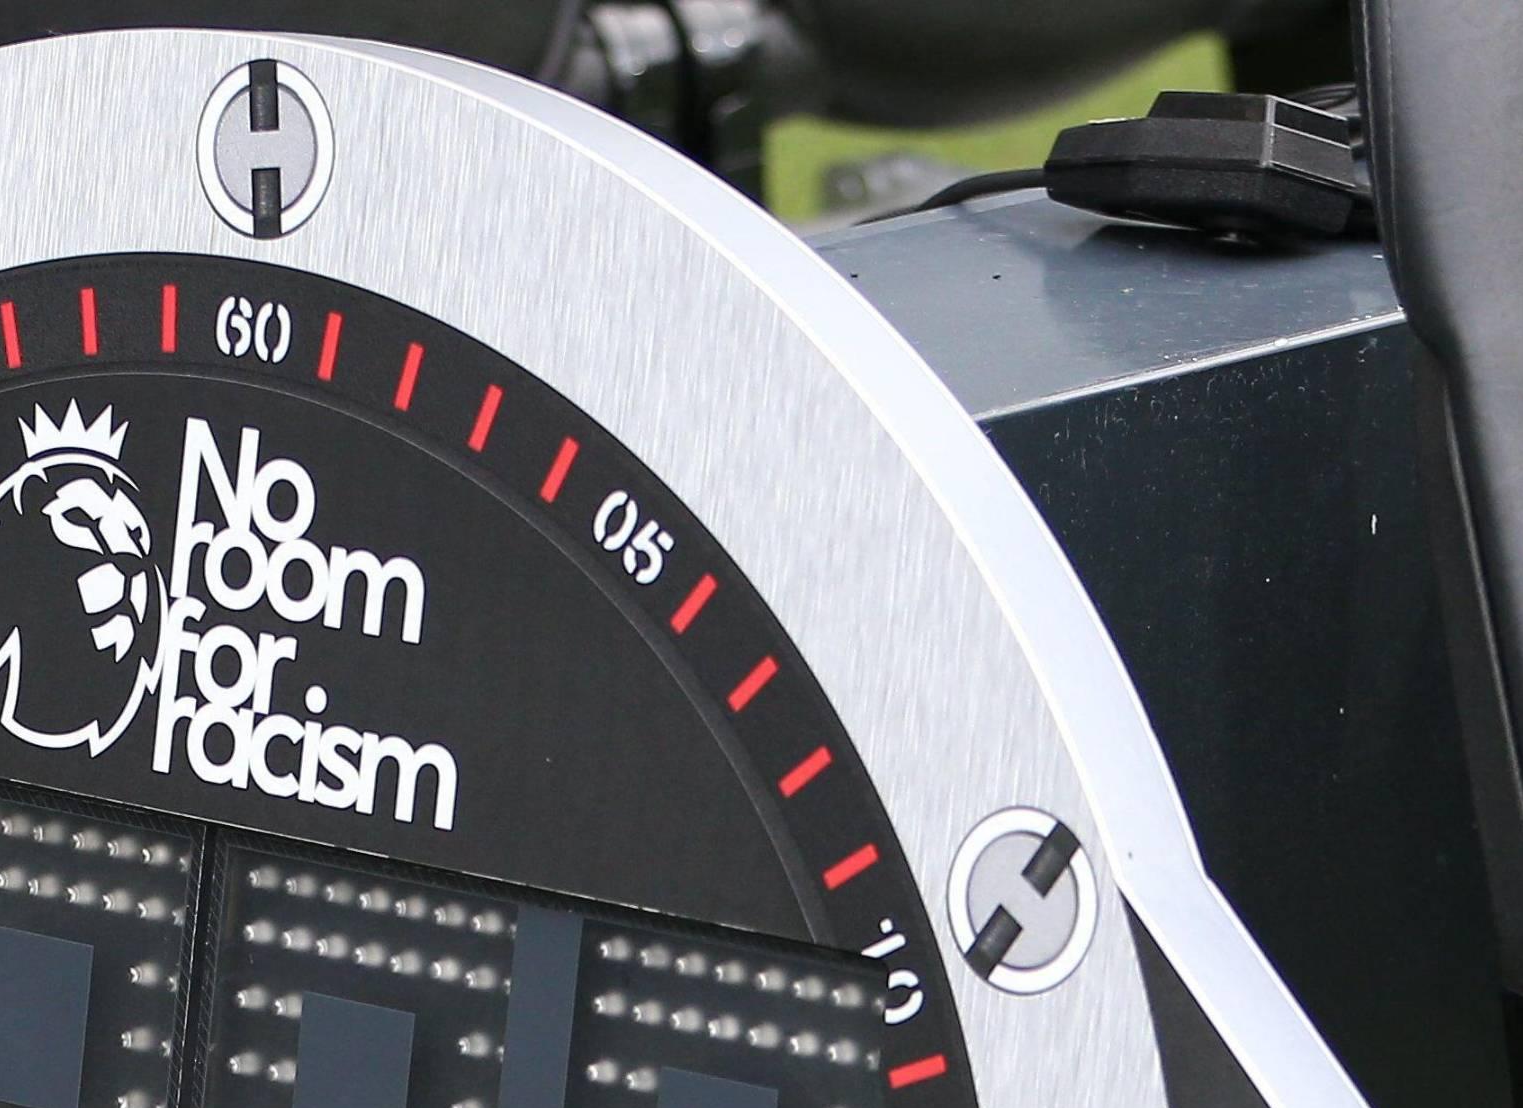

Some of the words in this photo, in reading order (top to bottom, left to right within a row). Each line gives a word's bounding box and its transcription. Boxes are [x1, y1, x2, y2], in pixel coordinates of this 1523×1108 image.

[215, 296, 292, 363] 60
[175, 417, 316, 543] No
[593, 490, 675, 584] 05
[171, 520, 426, 645] room
[161, 597, 297, 715] for
[152, 684, 459, 831] racism
